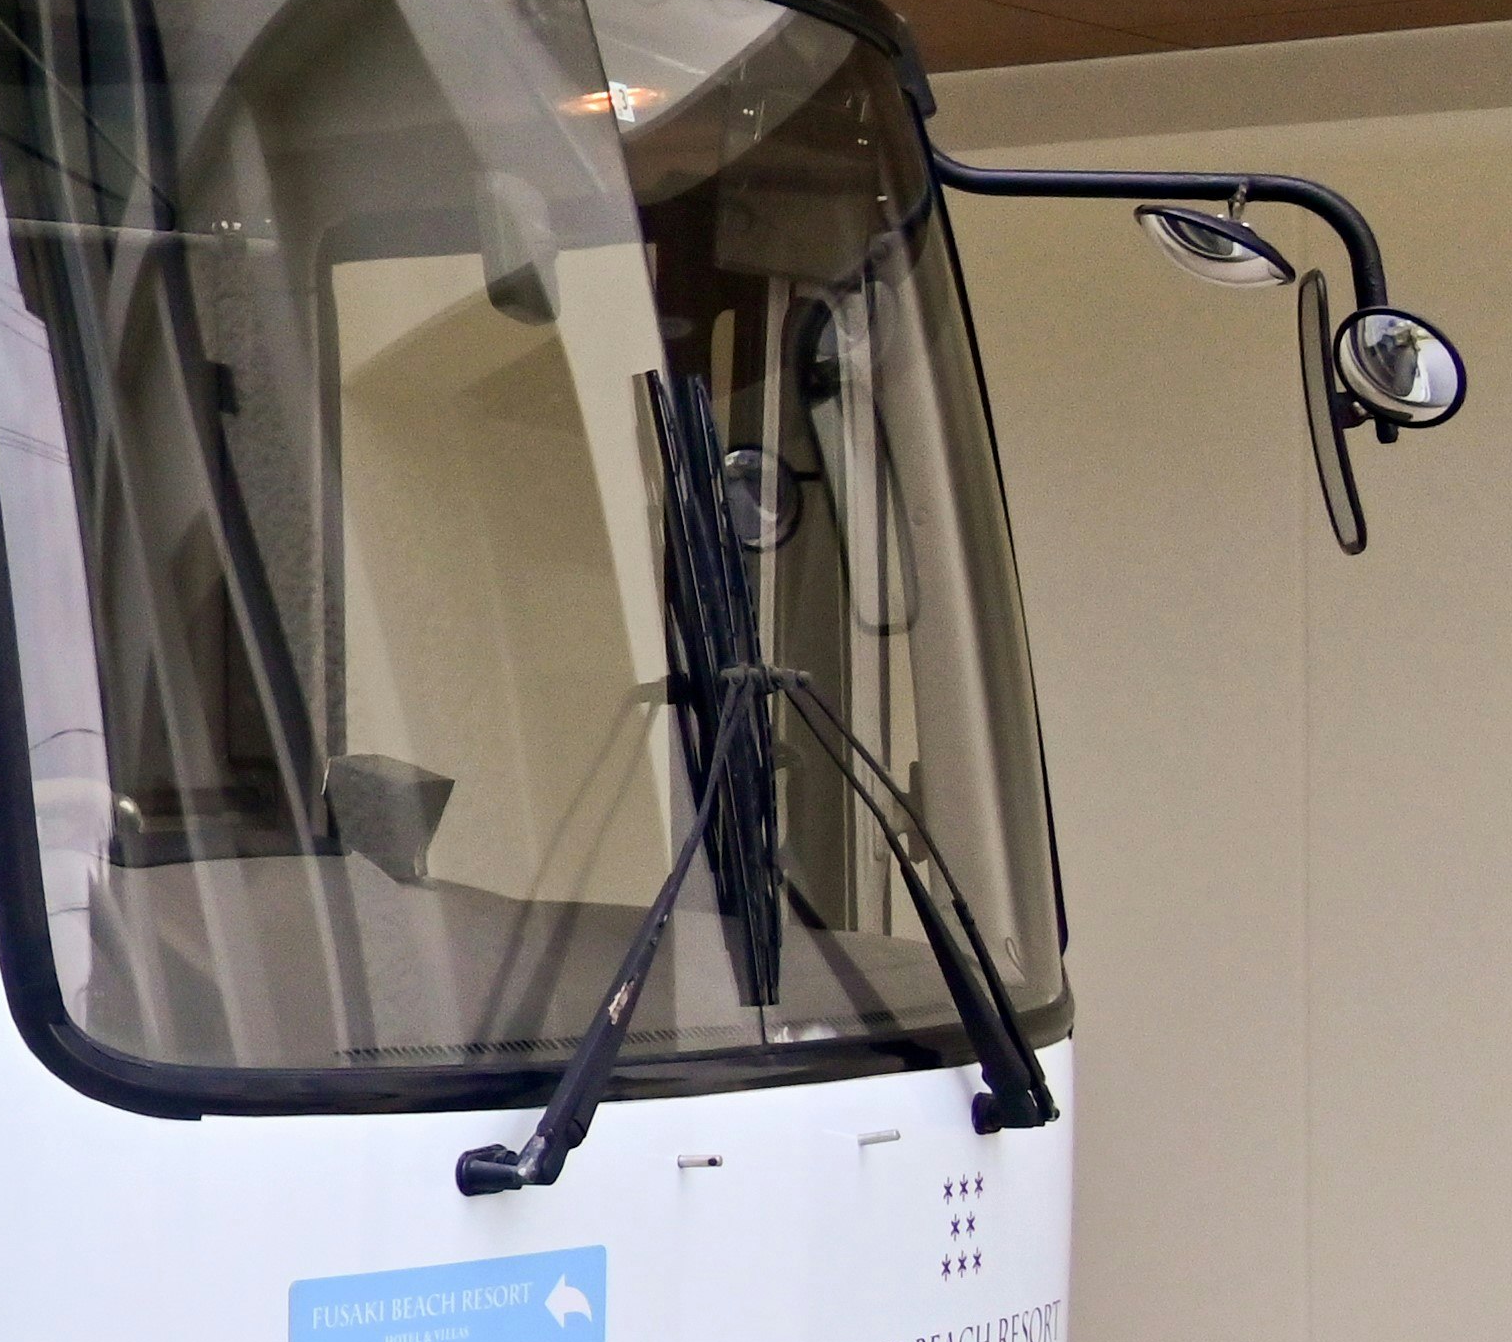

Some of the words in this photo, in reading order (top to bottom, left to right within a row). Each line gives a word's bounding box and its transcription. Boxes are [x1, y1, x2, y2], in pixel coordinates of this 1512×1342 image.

[312, 1300, 385, 1329] FUSAKI
[392, 1291, 456, 1322] BEACH
[462, 1281, 534, 1314] RESORT
[434, 1326, 470, 1342] VILLAS
